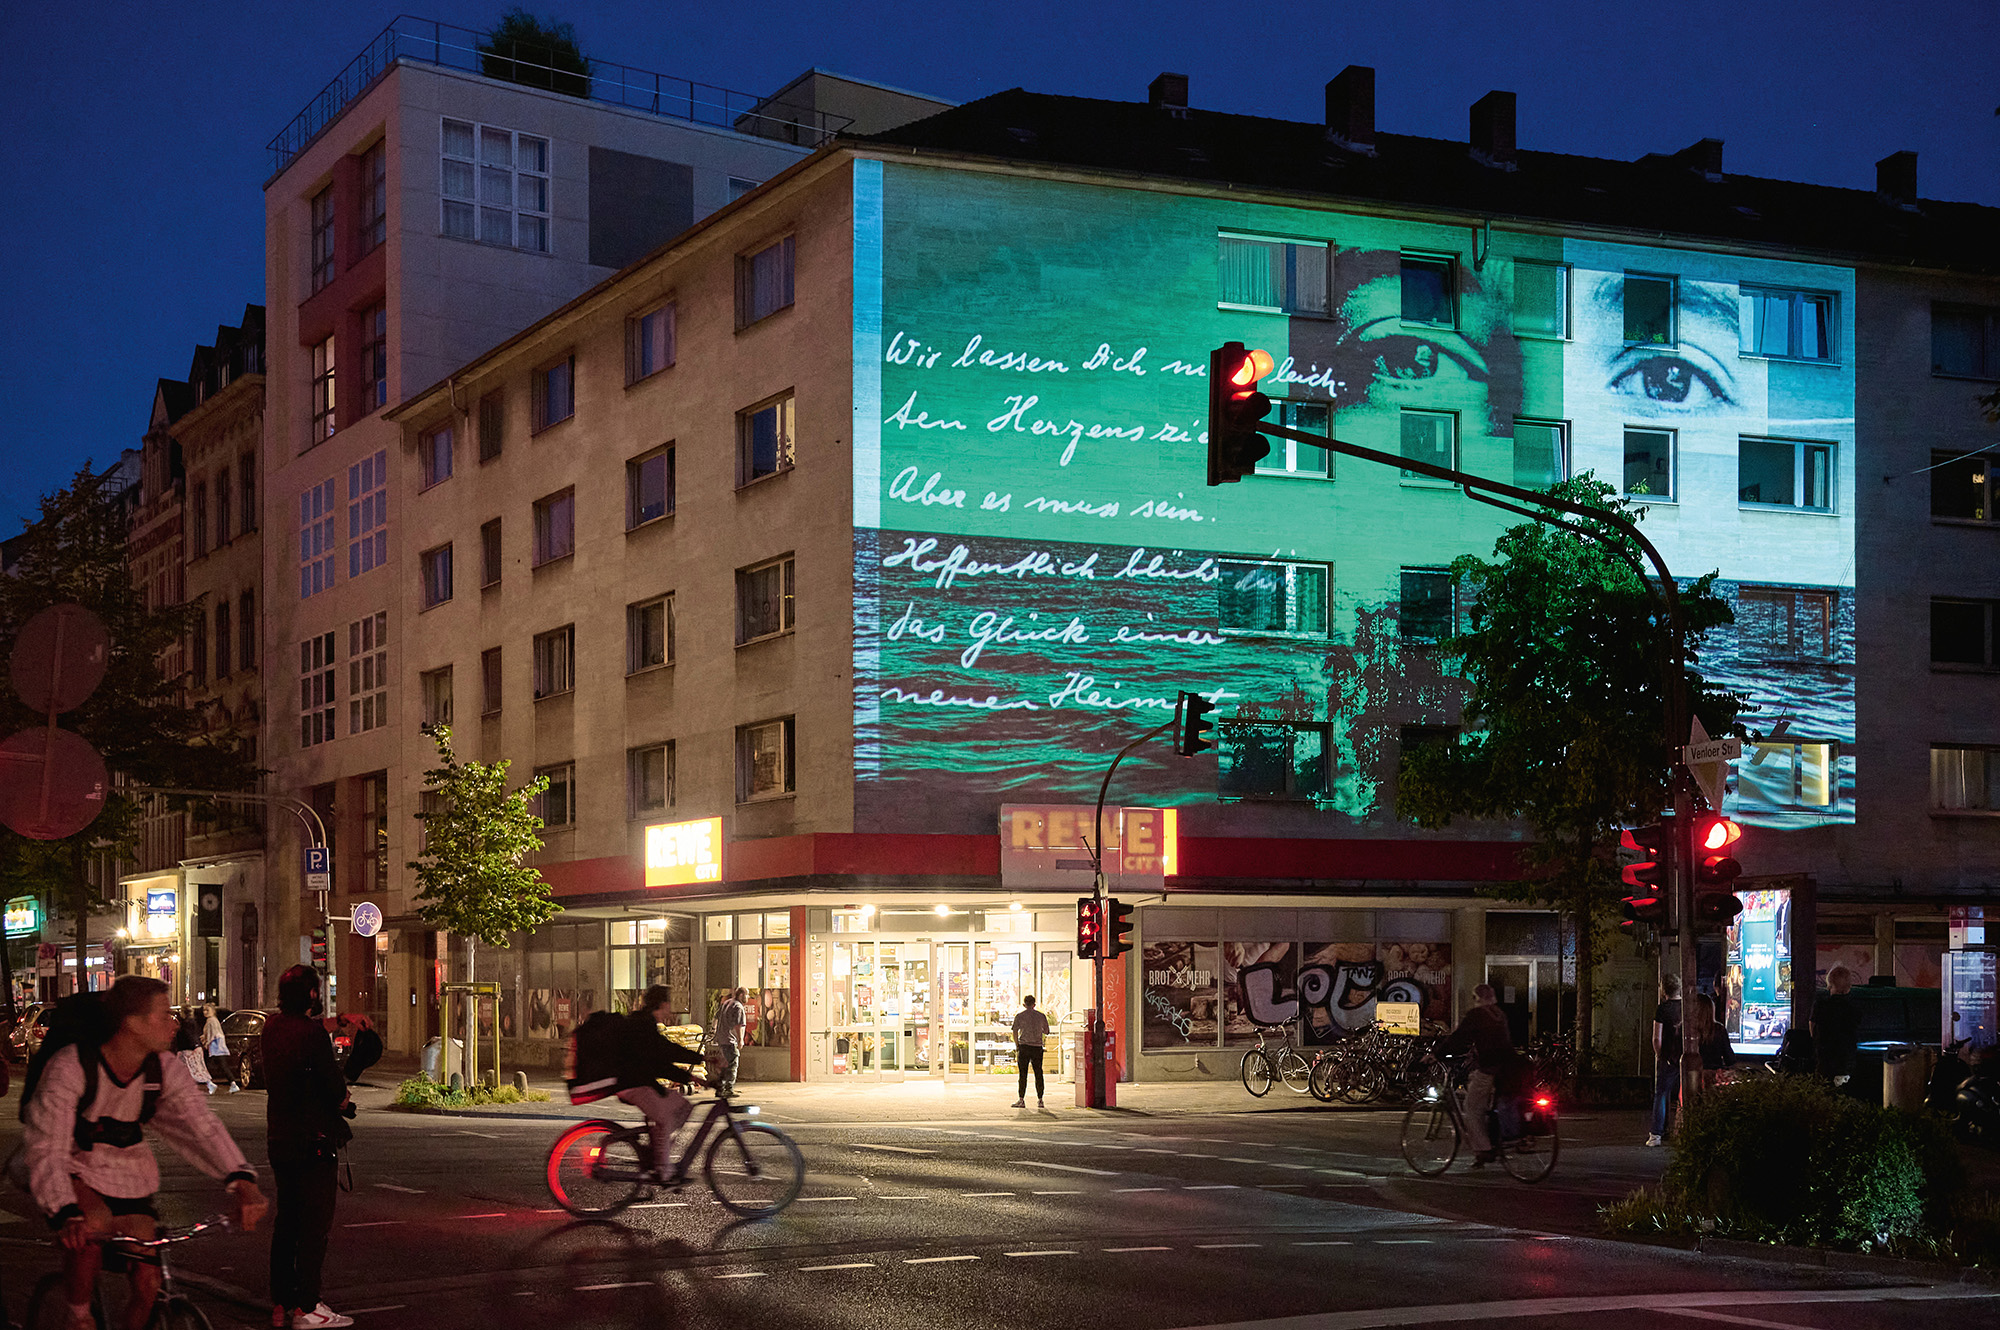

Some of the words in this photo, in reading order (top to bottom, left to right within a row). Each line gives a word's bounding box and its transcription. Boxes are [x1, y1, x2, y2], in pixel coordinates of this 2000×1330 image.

[886, 331, 942, 369] Wir
[952, 334, 1070, 373] lassen
[1082, 342, 1147, 377] Dich
[987, 395, 1145, 467] Herzens
[1150, 419, 1209, 443] zie
[888, 466, 967, 510] Aber
[980, 491, 1012, 514] es
[1024, 494, 1120, 521] muss
[1130, 492, 1217, 523] sein.
[882, 537, 1096, 590] Hoffentlich
[887, 601, 945, 642] das
[961, 611, 1090, 670] Glück
[1109, 611, 1229, 646] einer
[880, 687, 1040, 711] neuen
[1049, 672, 1240, 714] Heimt.
[1691, 744, 1720, 760] Venloer
[647, 821, 712, 869] REWE
[1012, 810, 1155, 853] REWE
[695, 863, 719, 880] CITY
[1124, 855, 1169, 871] CITY
[1148, 970, 1171, 986] BROT
[1186, 970, 1211, 986] MEHR
[743, 1004, 756, 1013] EWE
